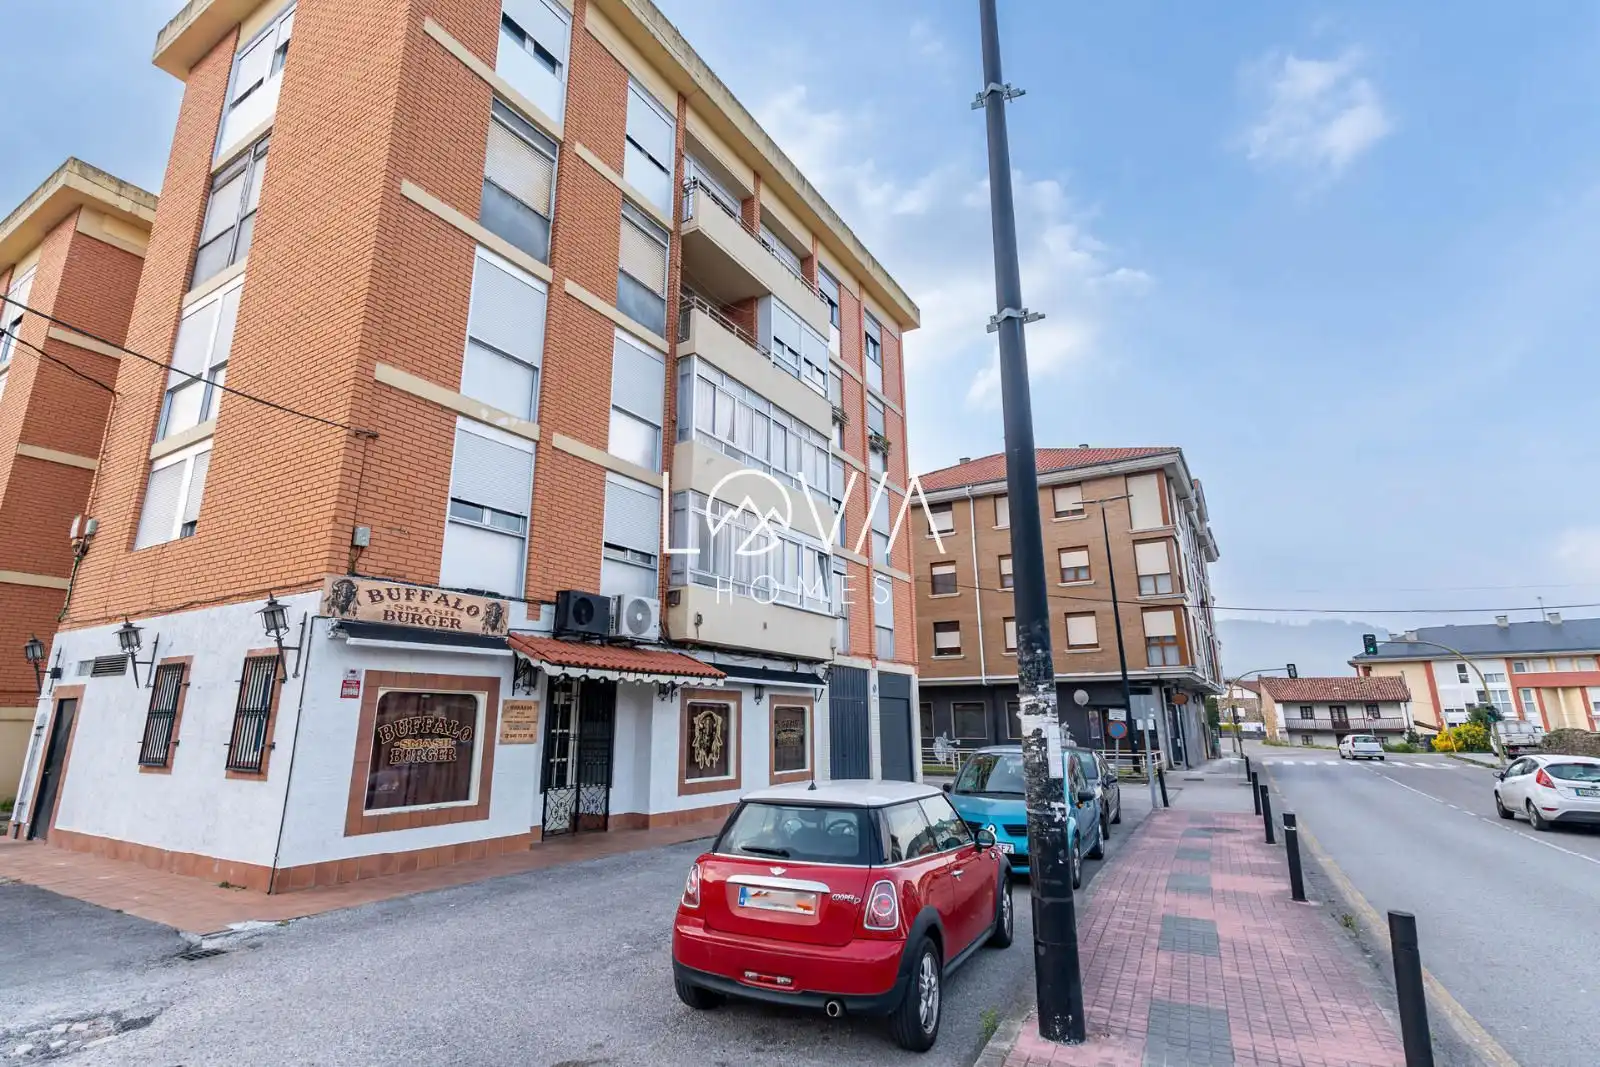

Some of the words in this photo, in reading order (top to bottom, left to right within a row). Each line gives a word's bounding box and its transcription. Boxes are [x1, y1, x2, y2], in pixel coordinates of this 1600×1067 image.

[366, 587, 480, 617] BUFFALO
[393, 603, 455, 618] SMASH
[383, 609, 463, 630] BURGER
[378, 715, 473, 744] BUFFALO
[399, 737, 453, 749] SMASH
[389, 746, 457, 764] BURGER
[831, 893, 855, 902] COOPER
